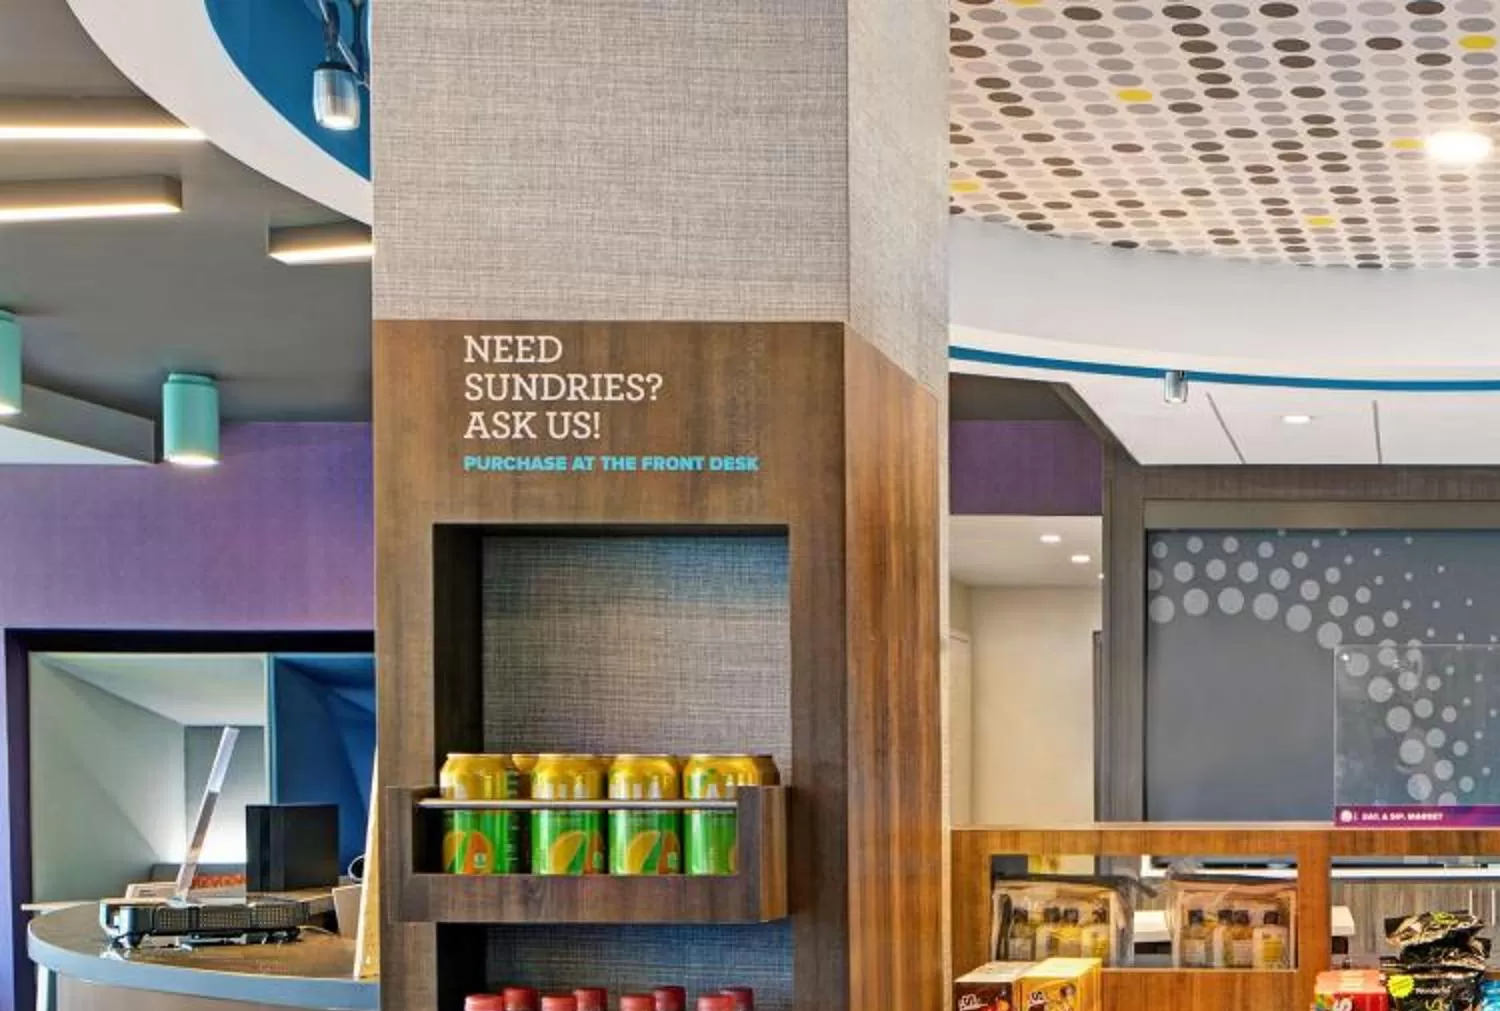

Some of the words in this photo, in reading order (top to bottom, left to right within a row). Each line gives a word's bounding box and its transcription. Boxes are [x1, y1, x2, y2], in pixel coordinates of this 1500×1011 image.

[463, 335, 563, 363] NEED
[463, 373, 663, 402] SUNDRIES?
[463, 410, 536, 439] ASK
[547, 410, 601, 439] US!
[463, 455, 567, 471] PURCHASE
[571, 456, 594, 471] AT
[601, 456, 637, 471] THE
[642, 456, 706, 471] FRONT
[709, 456, 760, 472] DESK
